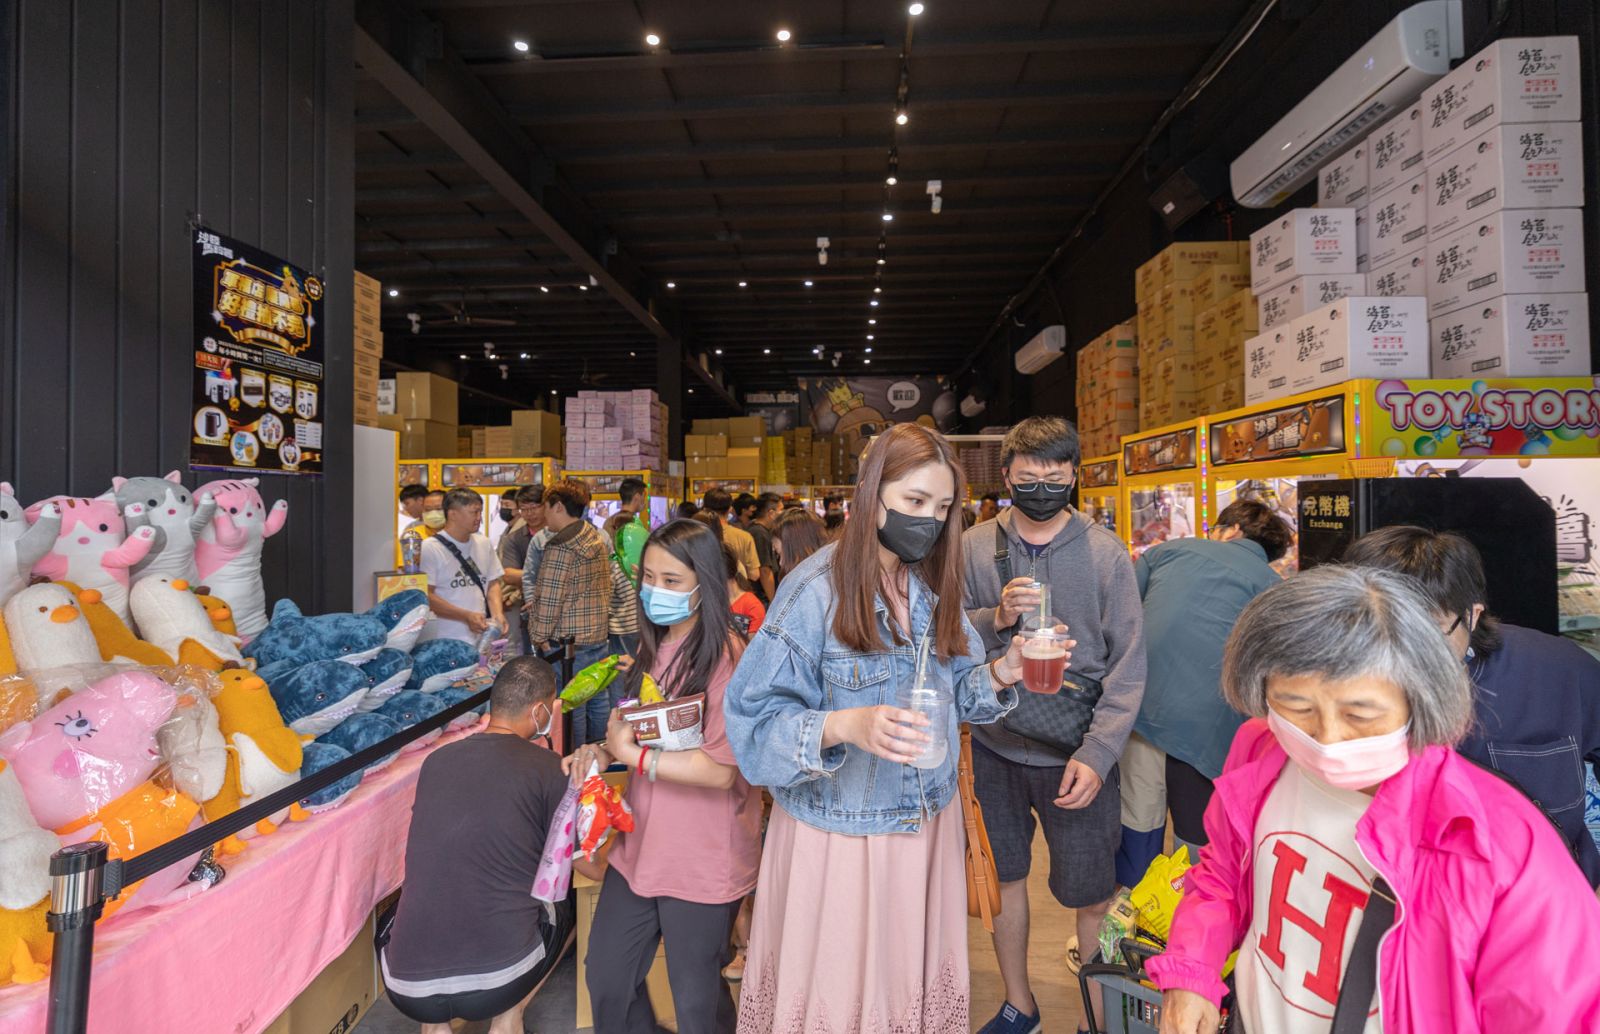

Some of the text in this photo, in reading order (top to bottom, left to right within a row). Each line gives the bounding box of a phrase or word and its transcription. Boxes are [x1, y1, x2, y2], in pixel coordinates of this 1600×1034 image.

[1385, 389, 1475, 432] TOY
[1309, 519, 1344, 530] Exchange
[1258, 839, 1370, 1007] H
